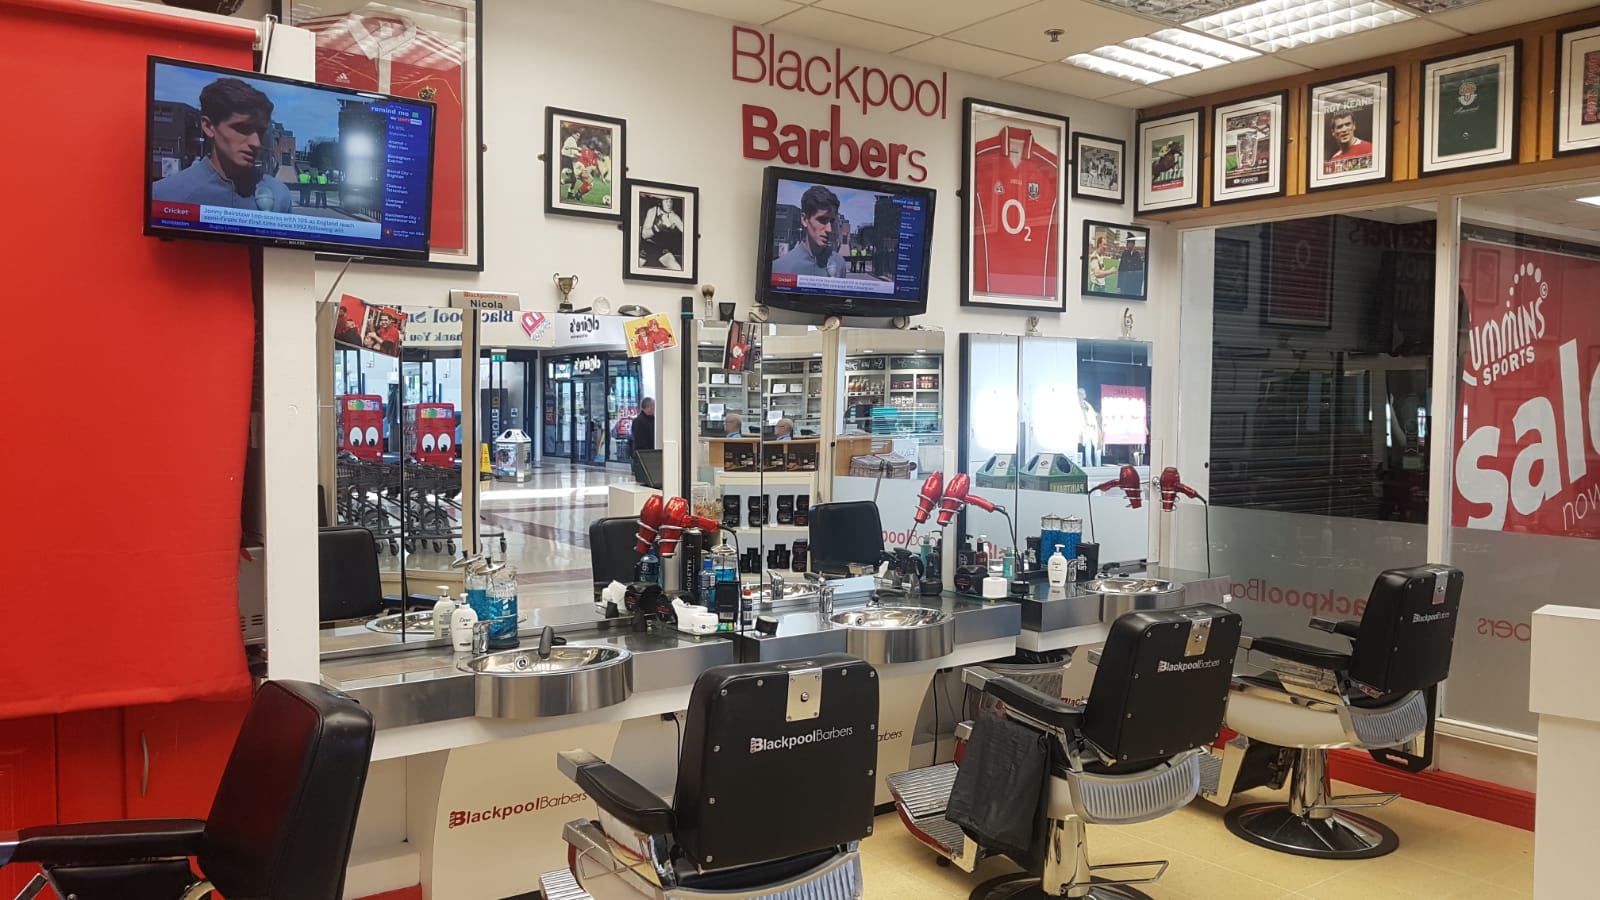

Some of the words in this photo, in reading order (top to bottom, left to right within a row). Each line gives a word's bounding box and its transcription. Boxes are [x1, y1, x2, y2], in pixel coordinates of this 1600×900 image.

[732, 25, 948, 119] Blackpool
[742, 103, 928, 182] Barbers
[163, 206, 189, 216] Cricket
[470, 299, 504, 309] Nicola
[1469, 297, 1546, 371] UMMINS
[1483, 346, 1535, 386] SPORTS
[1157, 658, 1221, 673] BlackpoolBarbers
[750, 725, 853, 754] BlackpoolBarbers
[448, 791, 588, 830] BlackpoolBarbers
